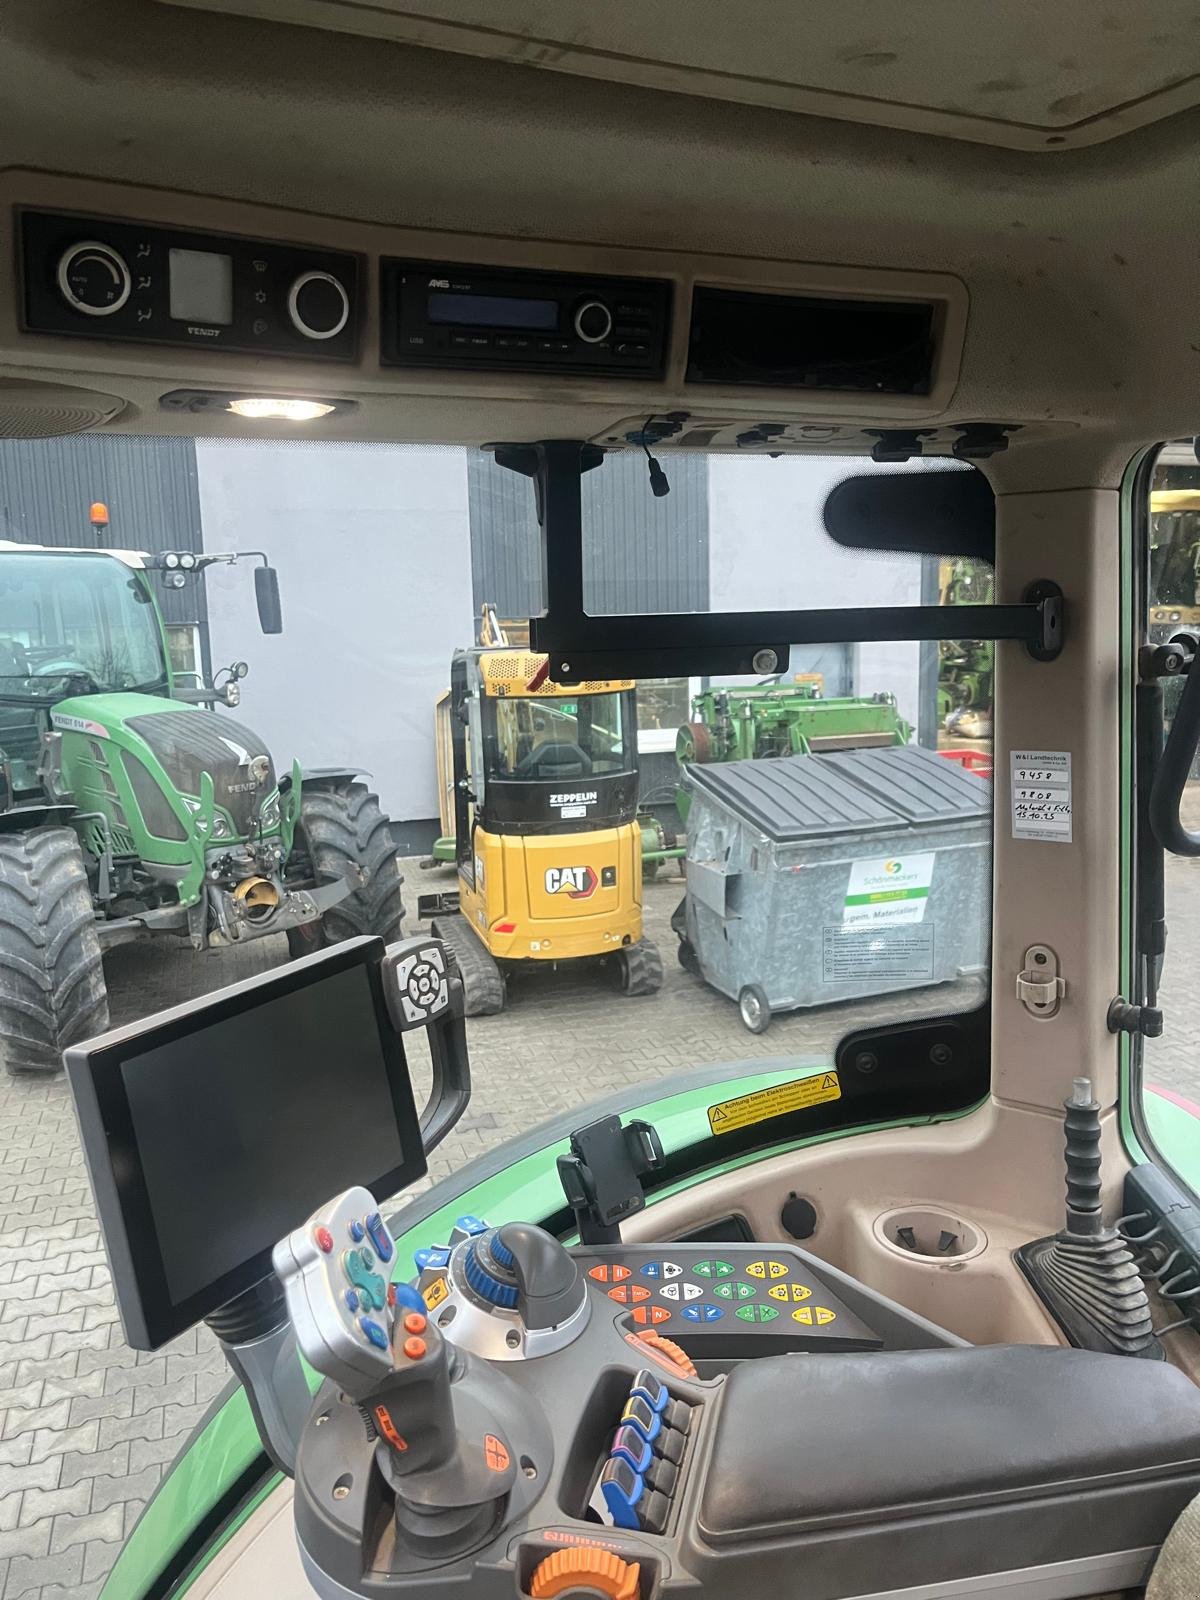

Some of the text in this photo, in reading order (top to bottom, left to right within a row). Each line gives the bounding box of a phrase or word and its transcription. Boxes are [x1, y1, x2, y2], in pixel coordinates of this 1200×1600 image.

[409, 336, 424, 345] USB
[54, 715, 73, 727] FENDT
[228, 782, 256, 794] FEND
[549, 791, 598, 803] ZEPPELIN
[545, 866, 587, 894] CAT
[873, 906, 919, 918] Materialien
[724, 1097, 750, 1109] Achtung
[750, 1092, 766, 1102] beim
[766, 1078, 820, 1096] Elektroschweißen
